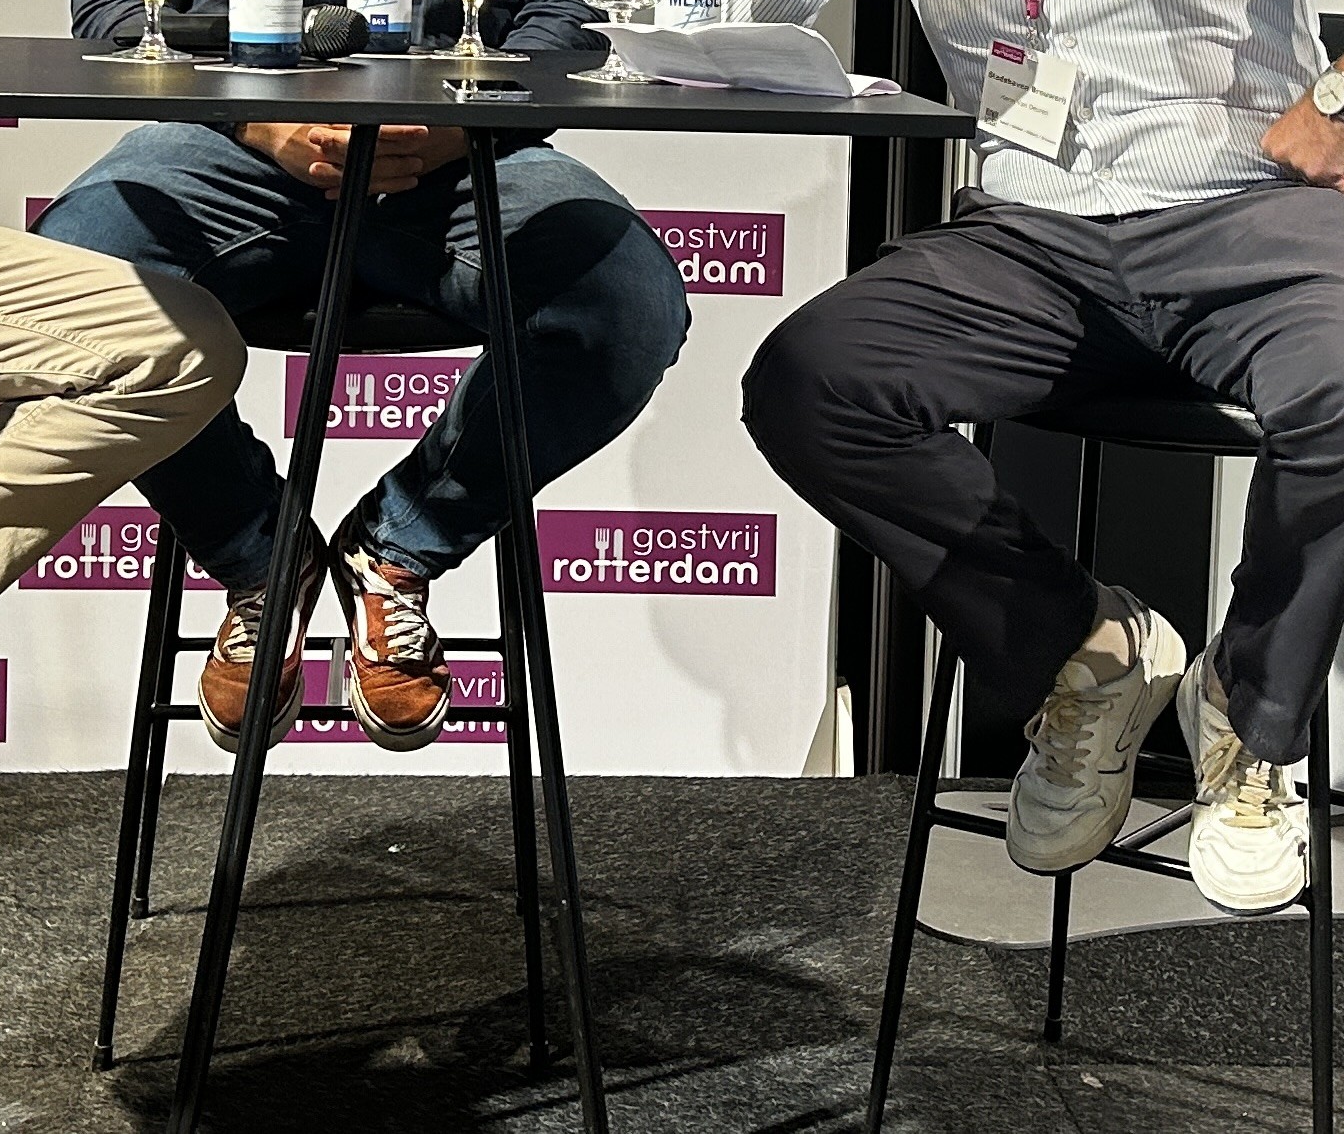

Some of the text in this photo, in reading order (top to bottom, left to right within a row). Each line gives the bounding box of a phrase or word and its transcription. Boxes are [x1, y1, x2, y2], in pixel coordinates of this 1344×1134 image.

[651, 222, 768, 258] astvrij
[384, 368, 462, 402] gast
[325, 395, 447, 429] otterd
[632, 523, 759, 558] gastvrij
[553, 546, 759, 586] rotterdam
